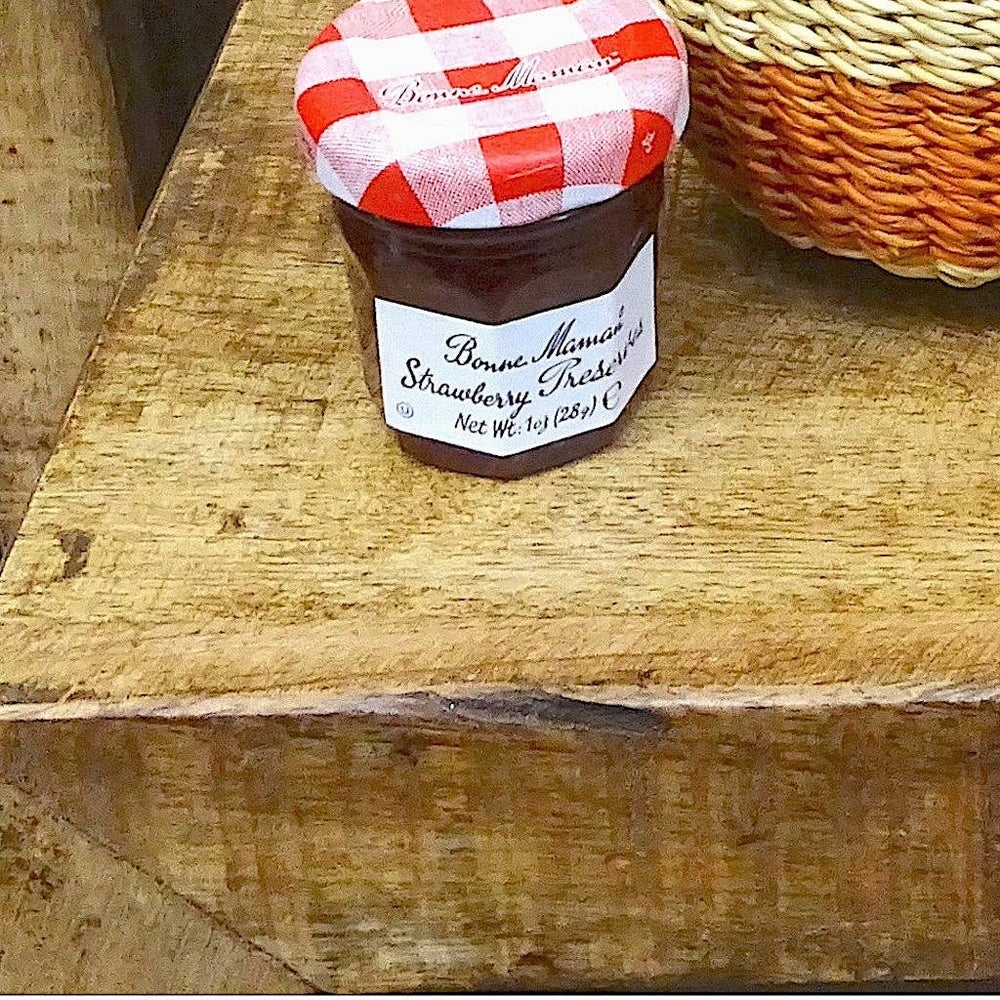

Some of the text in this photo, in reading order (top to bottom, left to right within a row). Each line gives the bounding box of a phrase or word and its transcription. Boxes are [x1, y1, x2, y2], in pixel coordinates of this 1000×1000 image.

[444, 305, 625, 372] Bonne Maman
[400, 358, 532, 418] Strawberry
[454, 413, 488, 436] Net
